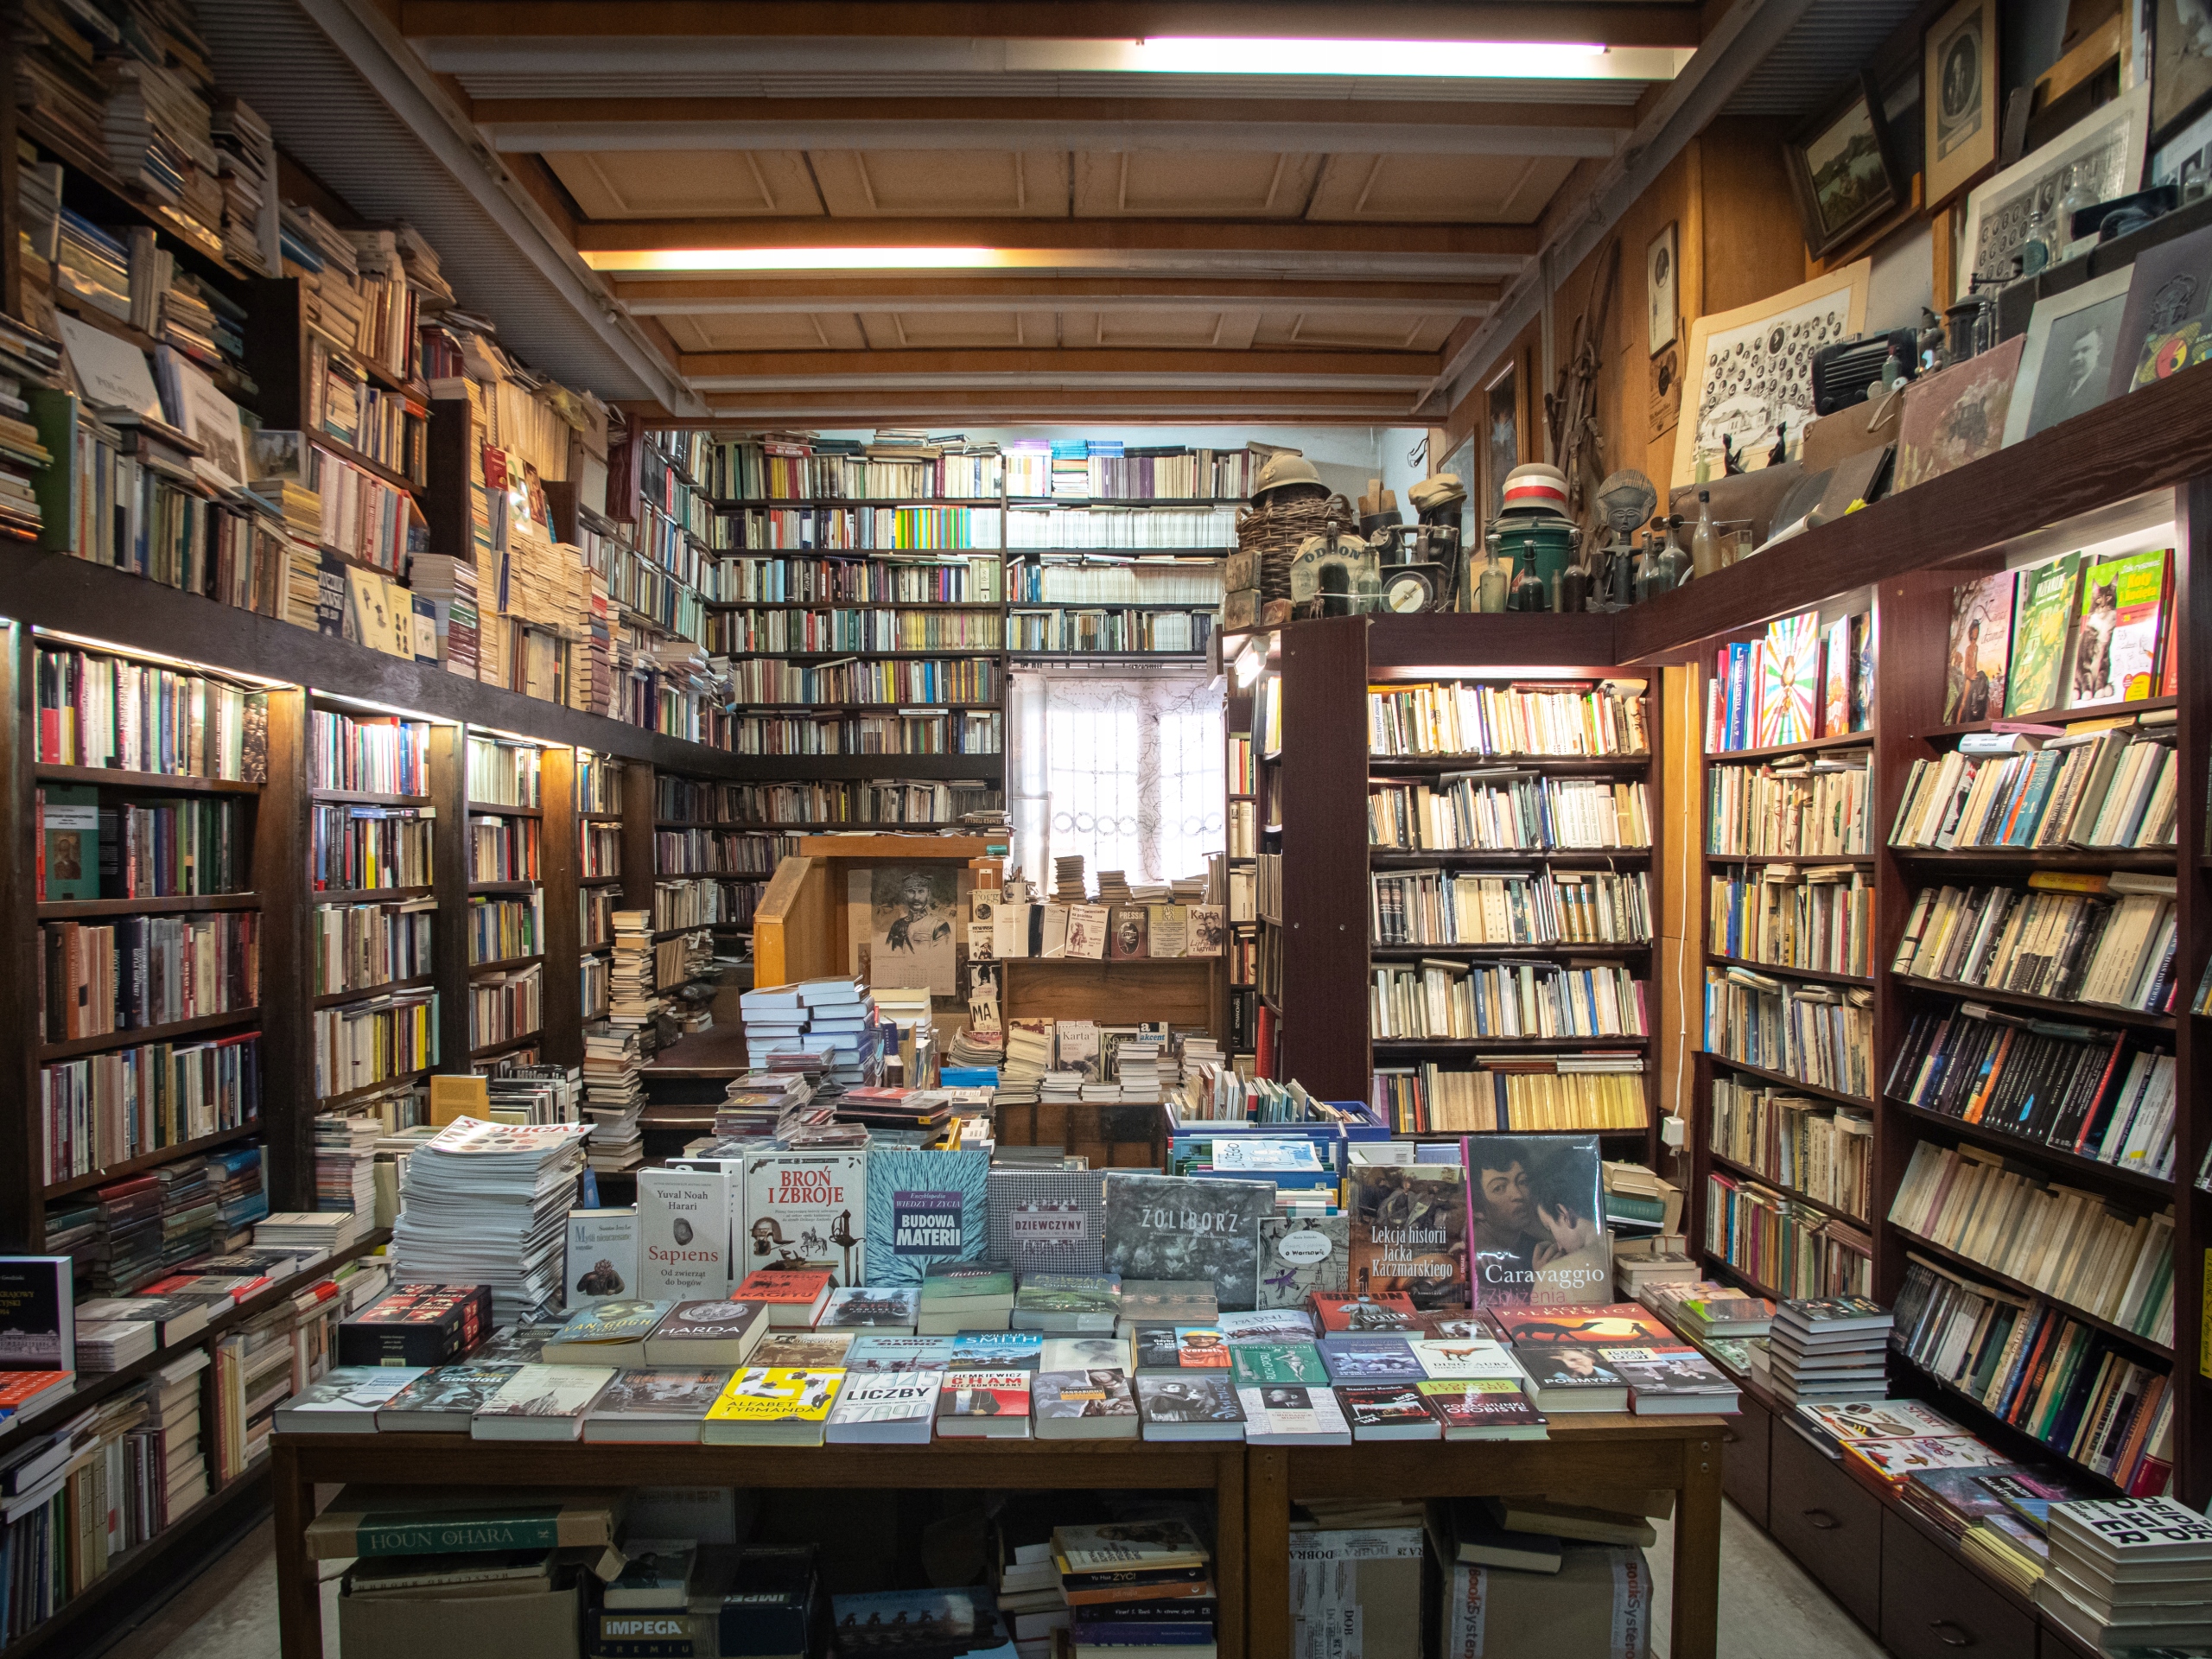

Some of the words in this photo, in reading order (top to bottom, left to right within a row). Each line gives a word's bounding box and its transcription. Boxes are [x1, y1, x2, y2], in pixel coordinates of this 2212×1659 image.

[1305, 545, 1361, 563] ODON
[2127, 572, 2153, 588] Koty
[1119, 911, 1146, 920] PRESSJE
[1191, 909, 1219, 919] Karta
[973, 1004, 992, 1021] MA
[1140, 1022, 1151, 1033] a
[1063, 1031, 1090, 1040] Karta
[1140, 1033, 1165, 1041] akcent
[517, 1070, 549, 1080] Hitler
[780, 1166, 831, 1187] BROŃ
[657, 1190, 682, 1199] Yuval
[684, 1191, 709, 1199] Noah
[768, 1187, 774, 1204] I
[779, 1187, 844, 1207] ZBROJE
[668, 1202, 697, 1211] Harari
[936, 1198, 961, 1208] ŻYCIA
[901, 1215, 956, 1229] BUDOWA
[1014, 1220, 1082, 1231] DZIEWCZYNY
[1141, 1205, 1239, 1233] ŻOLIBORZ
[575, 1225, 595, 1243] Myśli
[596, 1233, 632, 1242] nieuczesane
[896, 1228, 961, 1247] MATERII
[1371, 1226, 1406, 1245] Lekcja
[1409, 1225, 1446, 1244] historii
[648, 1245, 719, 1265] Sapiens
[1382, 1244, 1413, 1262] Jacka
[675, 1269, 706, 1279] zwierząt
[1371, 1259, 1453, 1280] Kaczmarskiego
[1484, 1263, 1605, 1289] Caravaggio
[664, 1277, 675, 1286] do
[677, 1277, 702, 1288] bogów
[1486, 1287, 1567, 1306] Zbliżenia
[1363, 1312, 1409, 1322] SYSTEM
[1502, 1307, 1639, 1316] PAŁKIEWICZ
[563, 1321, 598, 1333] VAN
[603, 1318, 651, 1329] GOGH
[658, 1325, 740, 1336] HARDA
[1260, 1352, 1274, 1367] OPORU
[1264, 1366, 1277, 1380] RUCH
[846, 1386, 931, 1401] LICZBY
[1904, 1406, 1944, 1427] SPORT
[1999, 1477, 2037, 1498] GWIAZDY
[1289, 1549, 1333, 1560] DOBRA
[1112, 1571, 1136, 1581] ŻYĆ!
